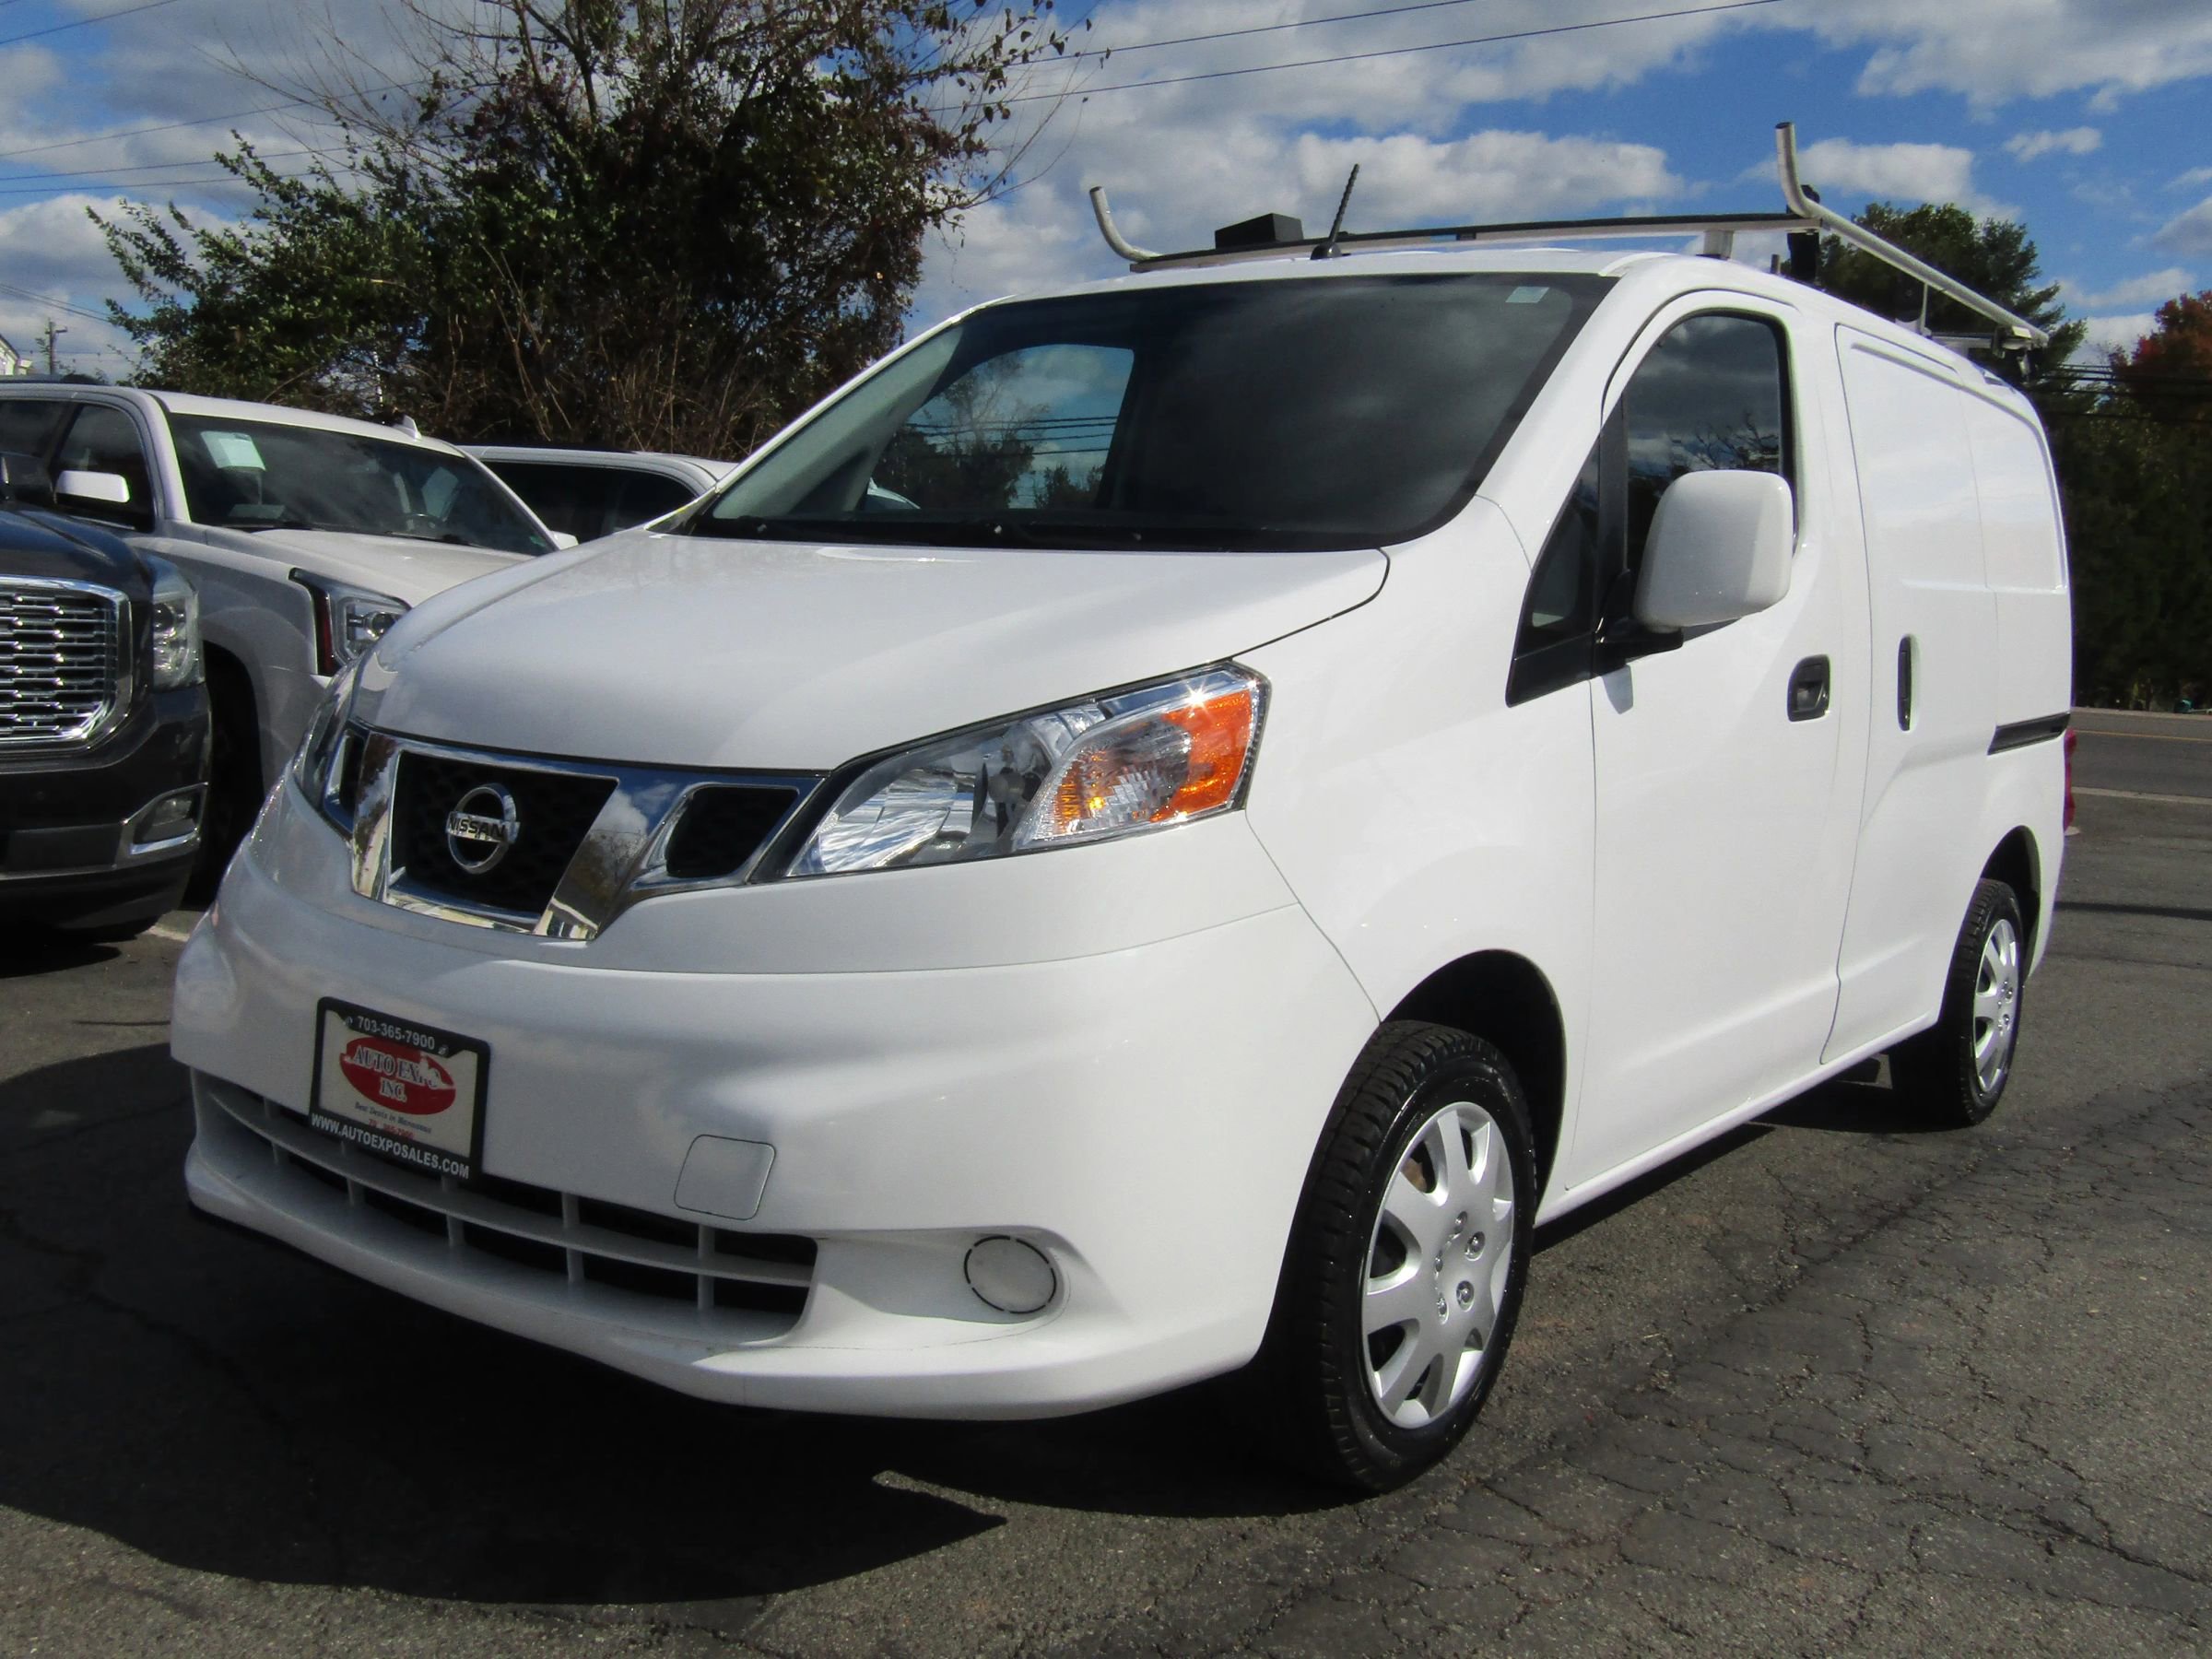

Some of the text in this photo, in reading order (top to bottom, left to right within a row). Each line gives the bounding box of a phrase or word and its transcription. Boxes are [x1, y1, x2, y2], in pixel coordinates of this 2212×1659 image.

[449, 816, 505, 840] NISSAN
[358, 1016, 435, 1050] 703-365-7900
[354, 1046, 395, 1075] AUTO
[381, 1078, 406, 1101] INC.
[312, 1113, 470, 1180] WWW.AUTOEXPOSALES.COM
